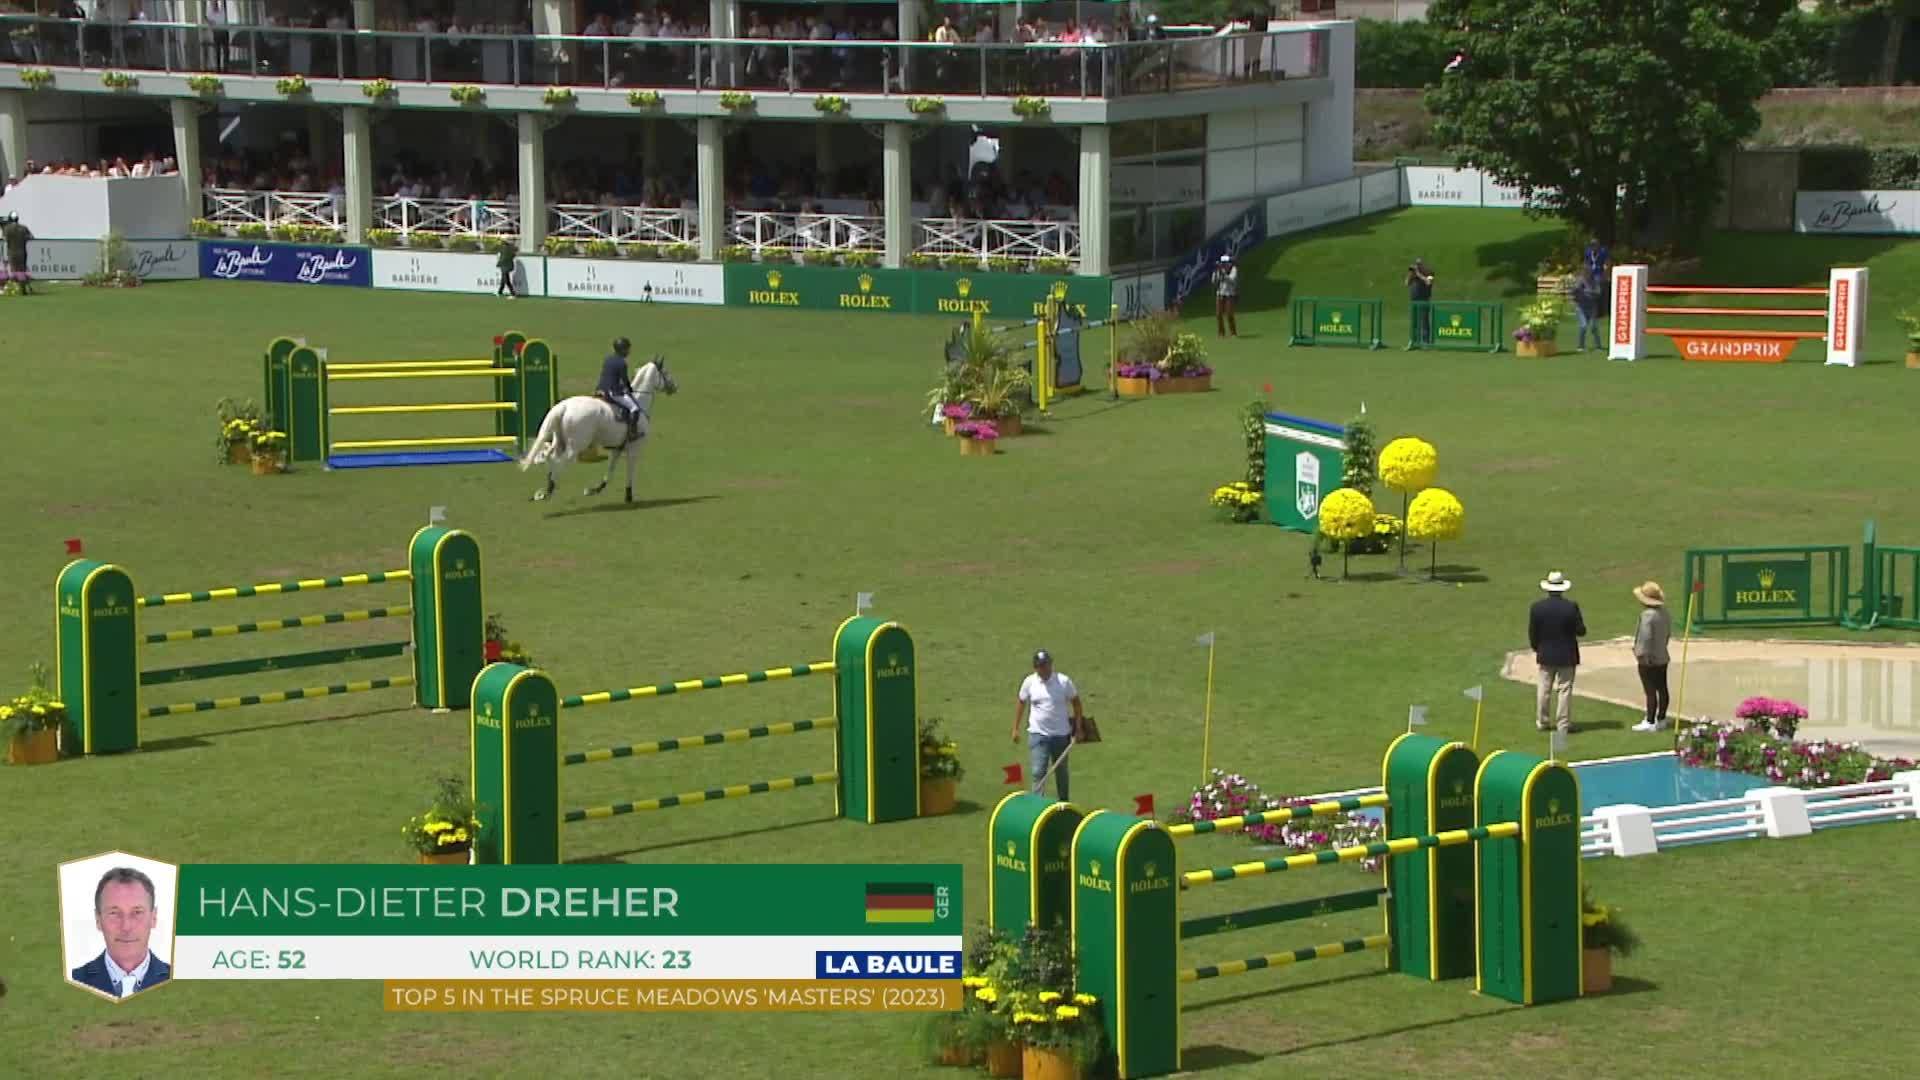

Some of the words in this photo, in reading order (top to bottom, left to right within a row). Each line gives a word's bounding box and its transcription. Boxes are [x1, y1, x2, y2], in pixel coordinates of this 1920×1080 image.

[225, 245, 273, 279] Baule
[309, 249, 356, 284] Baule
[749, 290, 800, 306] ROLEX
[839, 293, 891, 308] ROLEX
[937, 298, 991, 313] ROLEX
[1616, 278, 1632, 343] GRANDPRIX
[1834, 282, 1849, 349] GRANDPRIX
[1319, 323, 1353, 334] ROLEX
[1438, 326, 1473, 337] ROLEX
[1686, 340, 1781, 357] GRANDPRIX
[1735, 589, 1796, 604] ROLEX
[996, 853, 1027, 873] ROLEX
[1079, 873, 1112, 892] ROLEX
